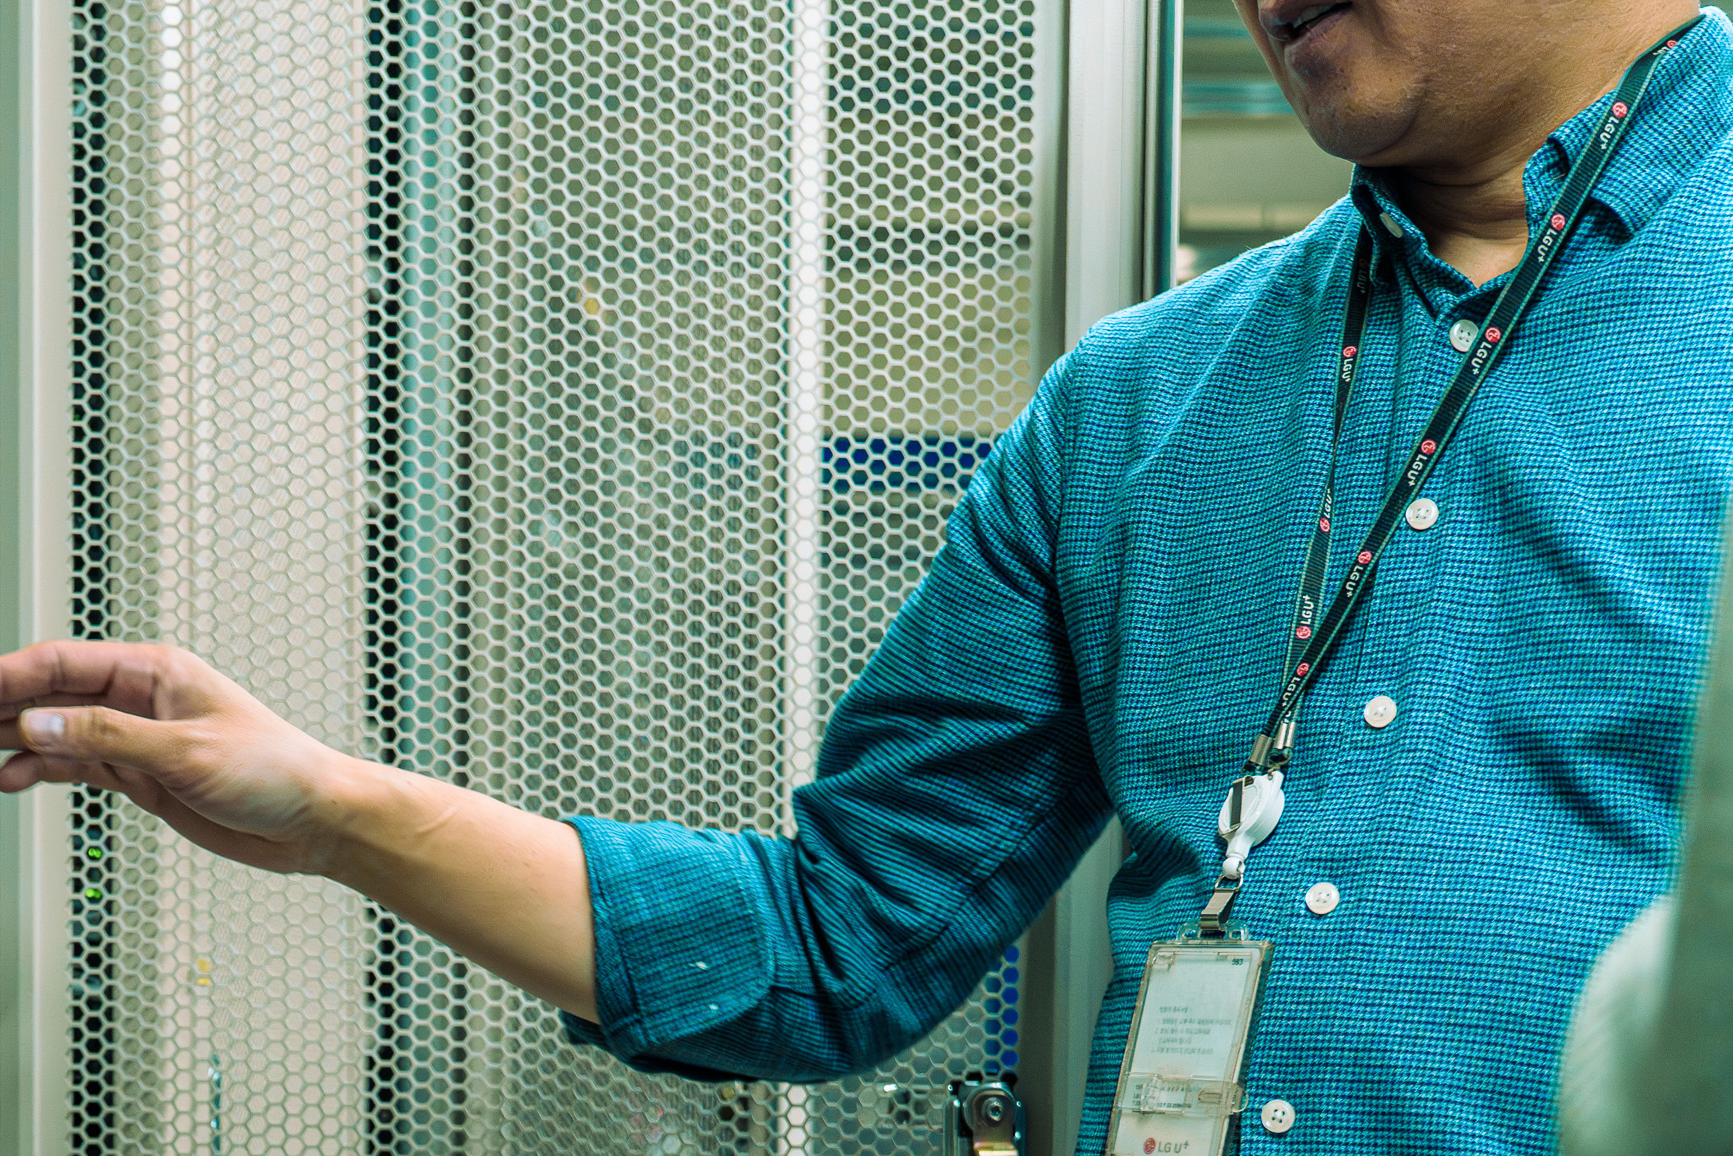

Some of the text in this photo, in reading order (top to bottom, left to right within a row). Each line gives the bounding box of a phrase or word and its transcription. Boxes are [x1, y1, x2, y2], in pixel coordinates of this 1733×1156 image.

[1599, 116, 1619, 150] LGU+
[1537, 228, 1558, 263] LGU+
[1341, 358, 1353, 382] LGU+
[1471, 341, 1492, 375] LGU+
[1407, 453, 1428, 487] LGU+
[1345, 565, 1364, 598] LGU+
[1300, 594, 1315, 625] LGU+
